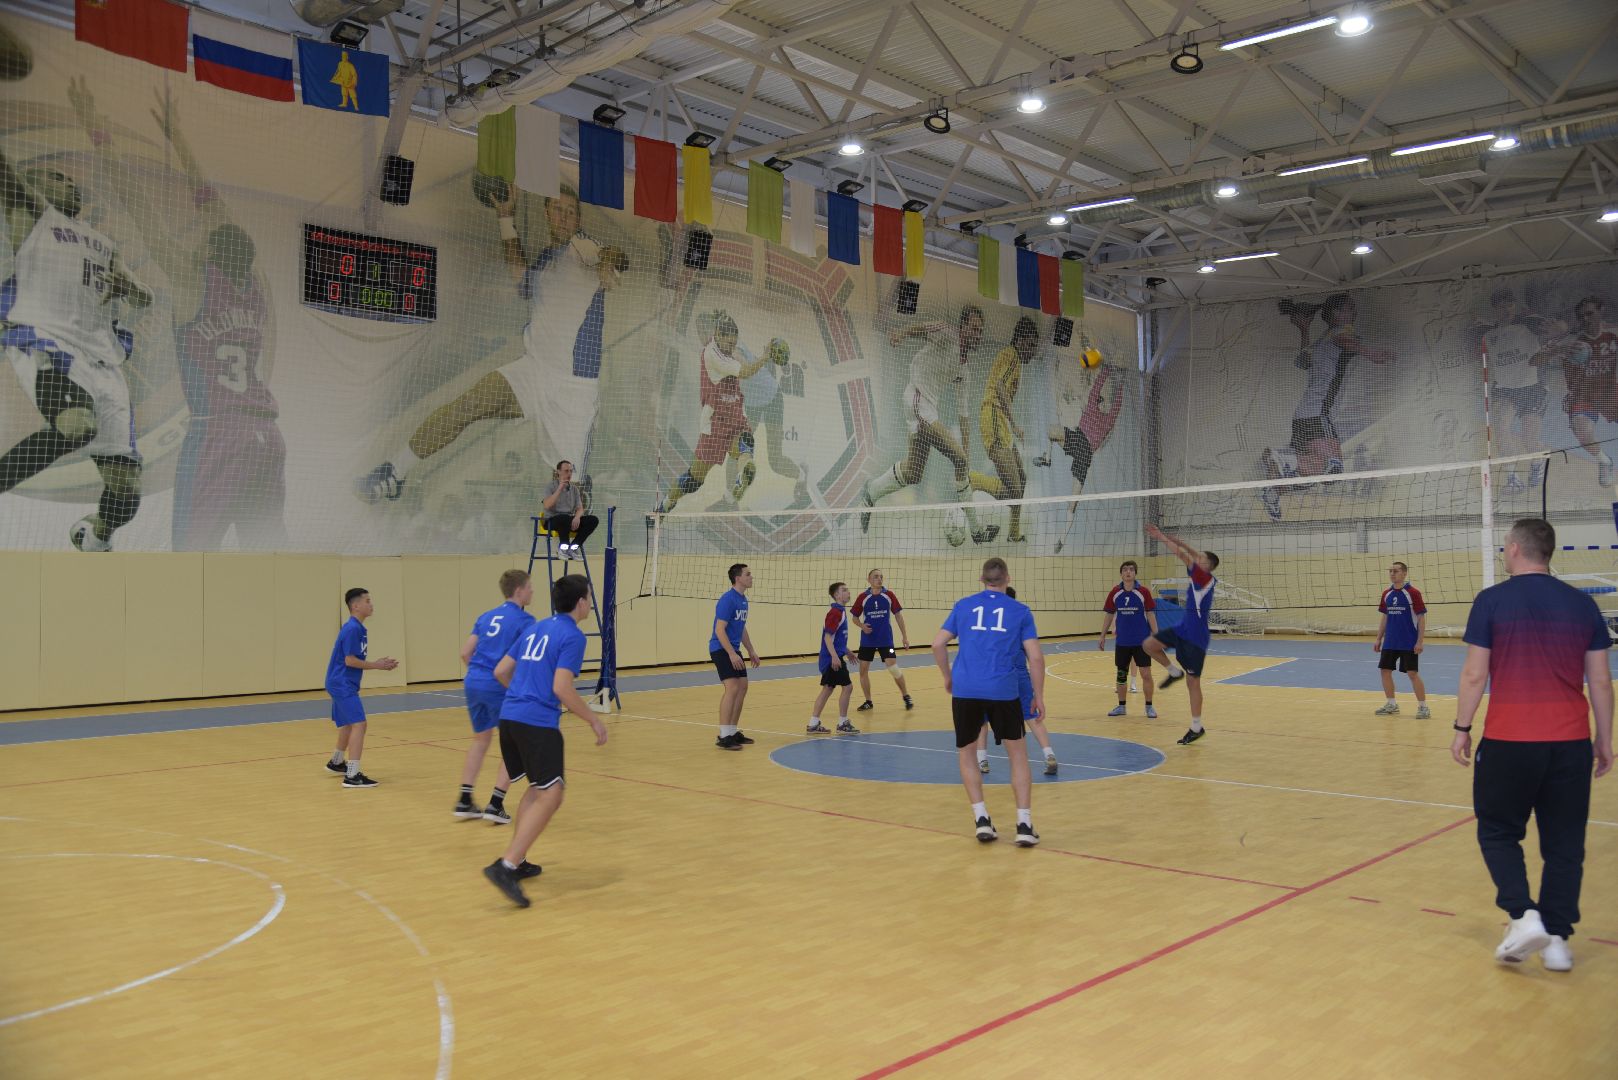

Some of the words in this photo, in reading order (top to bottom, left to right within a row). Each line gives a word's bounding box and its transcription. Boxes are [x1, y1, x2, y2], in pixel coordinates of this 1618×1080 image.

[341, 255, 353, 275] 0
[412, 267, 425, 286] 0
[216, 345, 247, 393] 3
[874, 600, 878, 610] 1
[1124, 596, 1130, 606] 7
[1392, 596, 1398, 606] 2
[486, 616, 504, 637] 5
[970, 605, 1007, 632] 11
[521, 633, 549, 661] 10
